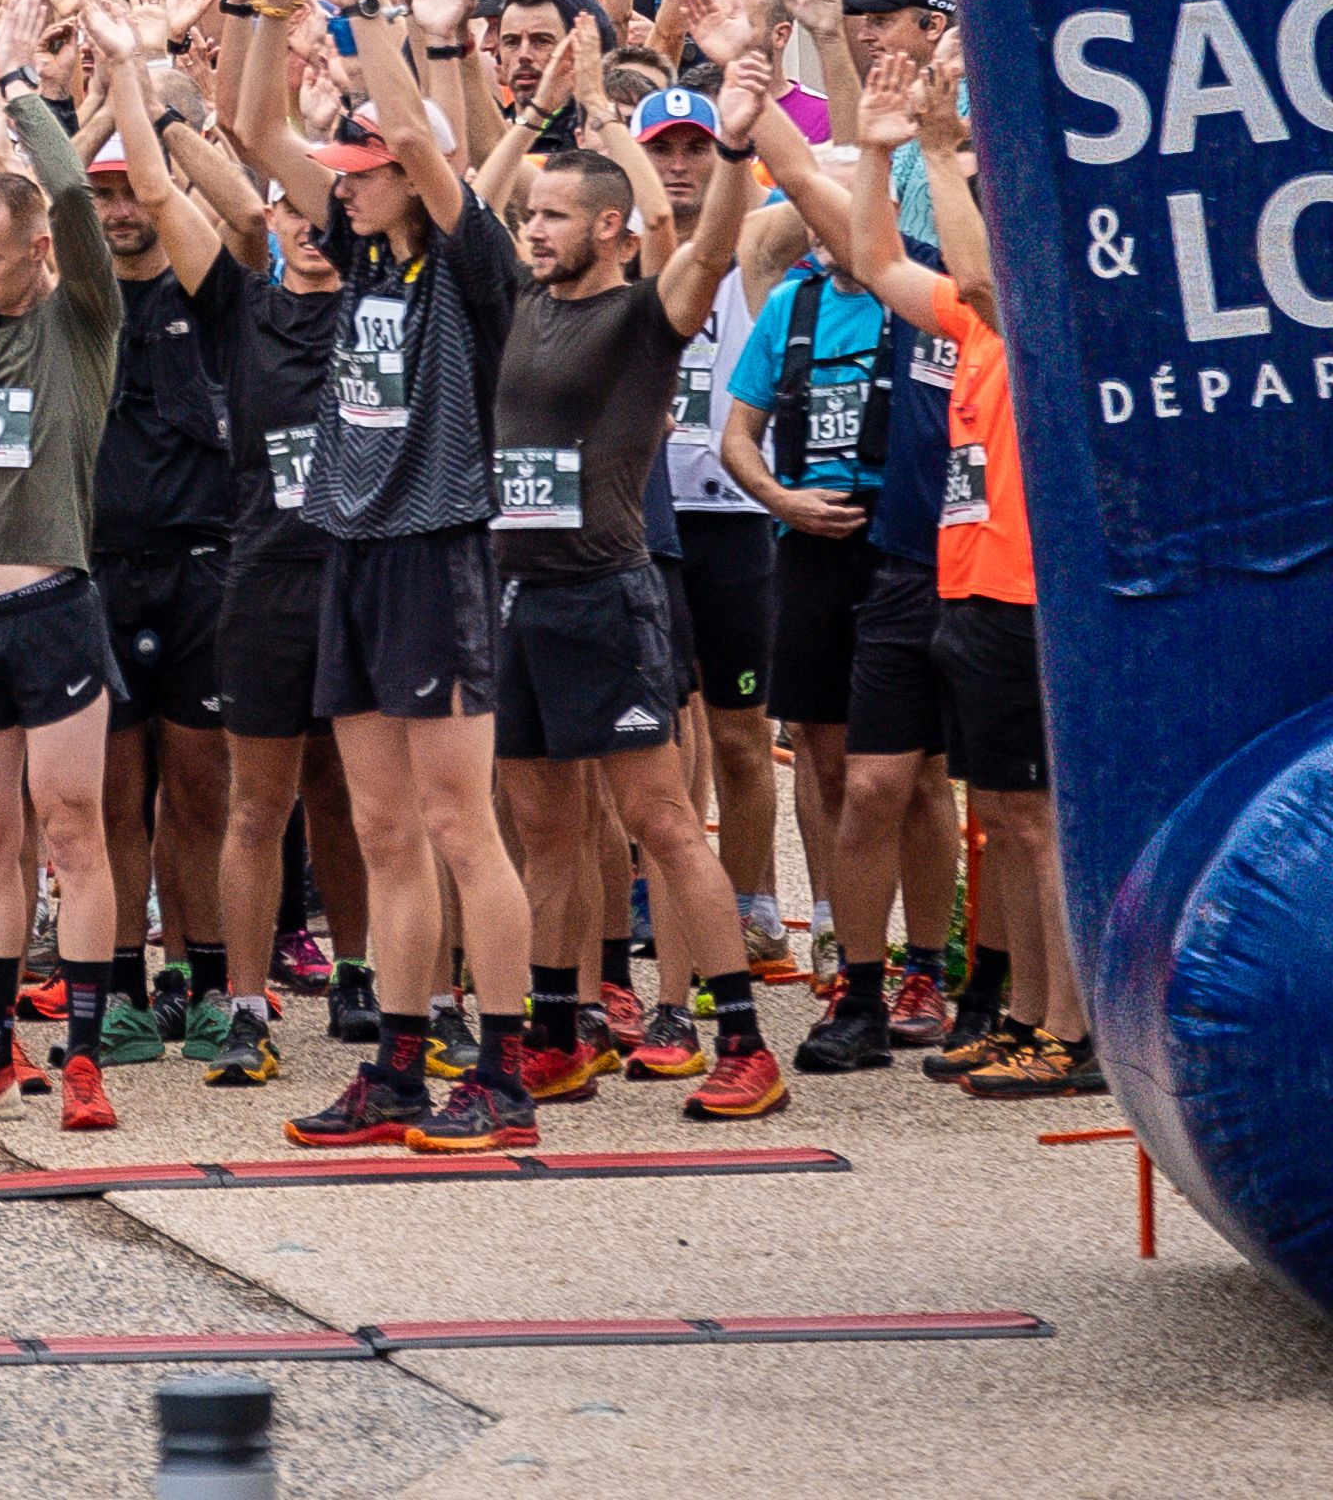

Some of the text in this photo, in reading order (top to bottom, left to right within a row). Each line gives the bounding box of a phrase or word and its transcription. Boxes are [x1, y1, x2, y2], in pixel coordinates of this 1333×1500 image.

[1087, 206, 1138, 280] &
[339, 377, 380, 406] 1126
[809, 410, 860, 441] 1315
[502, 478, 552, 505] 1312
